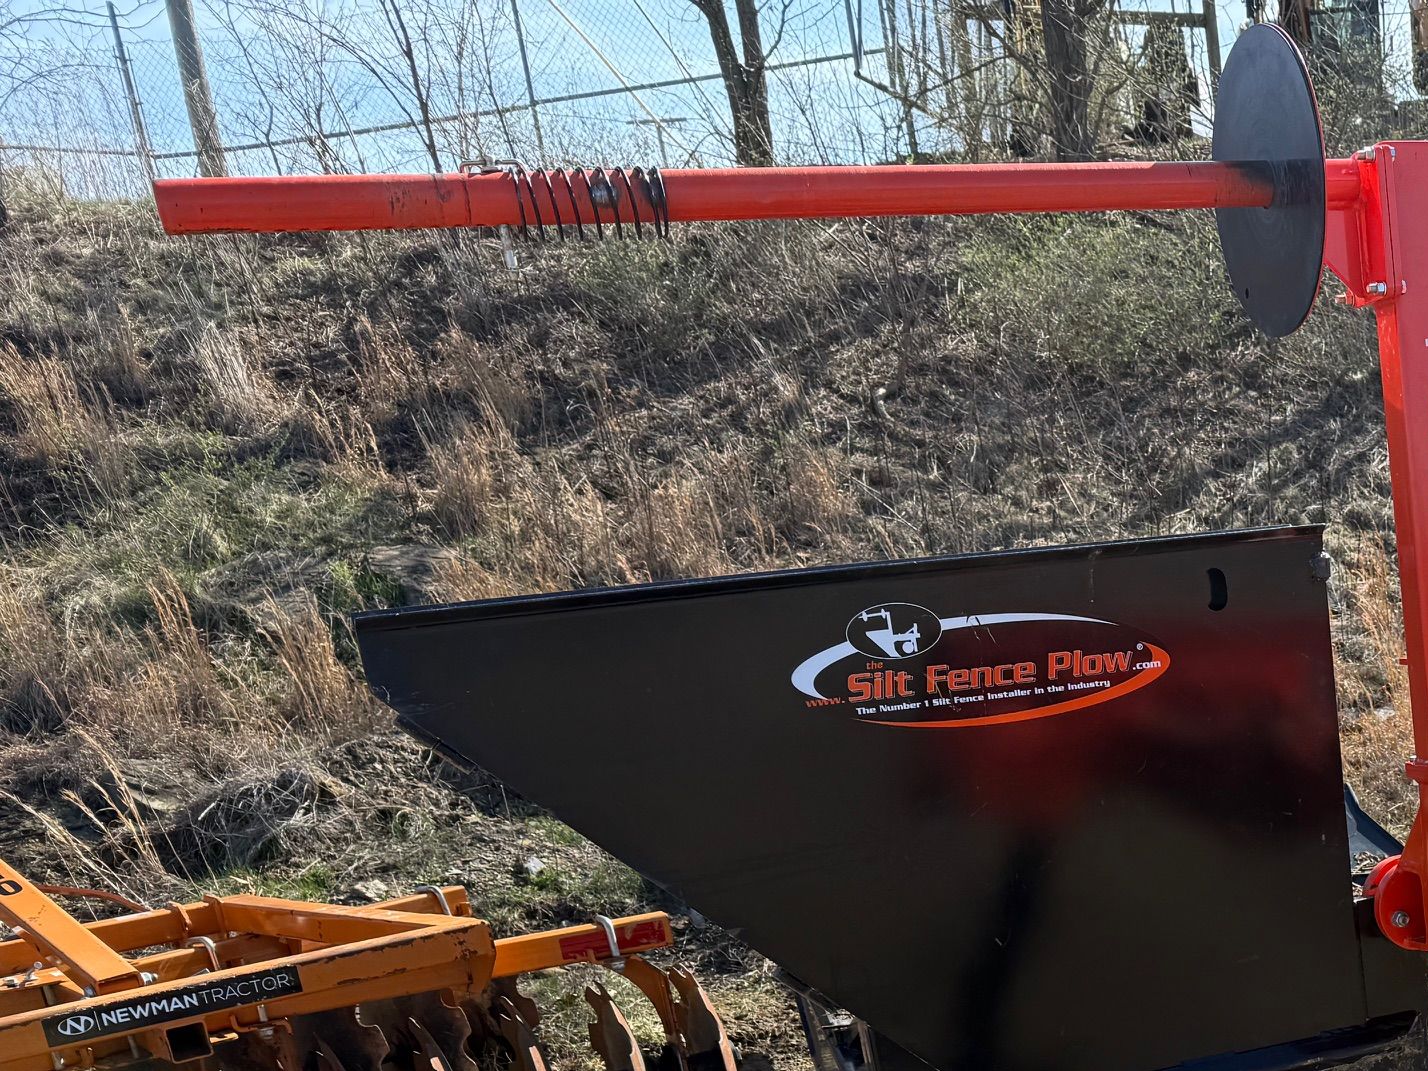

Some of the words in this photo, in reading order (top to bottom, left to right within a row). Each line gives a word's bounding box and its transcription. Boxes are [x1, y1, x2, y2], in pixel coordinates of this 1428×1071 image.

[806, 696, 845, 708] www.
[847, 669, 916, 704] Silt
[926, 661, 1037, 695] Fence
[1048, 649, 1134, 681] Plow
[1132, 660, 1161, 671] .com
[866, 660, 884, 670] the
[855, 706, 877, 716] The
[879, 700, 921, 713] Number
[924, 700, 930, 708] 1
[932, 696, 951, 707] Silt
[954, 694, 985, 705] Fence
[987, 688, 1032, 700] Installer
[1034, 686, 1045, 695] in
[1047, 684, 1065, 693] the
[1067, 679, 1111, 691] Industry
